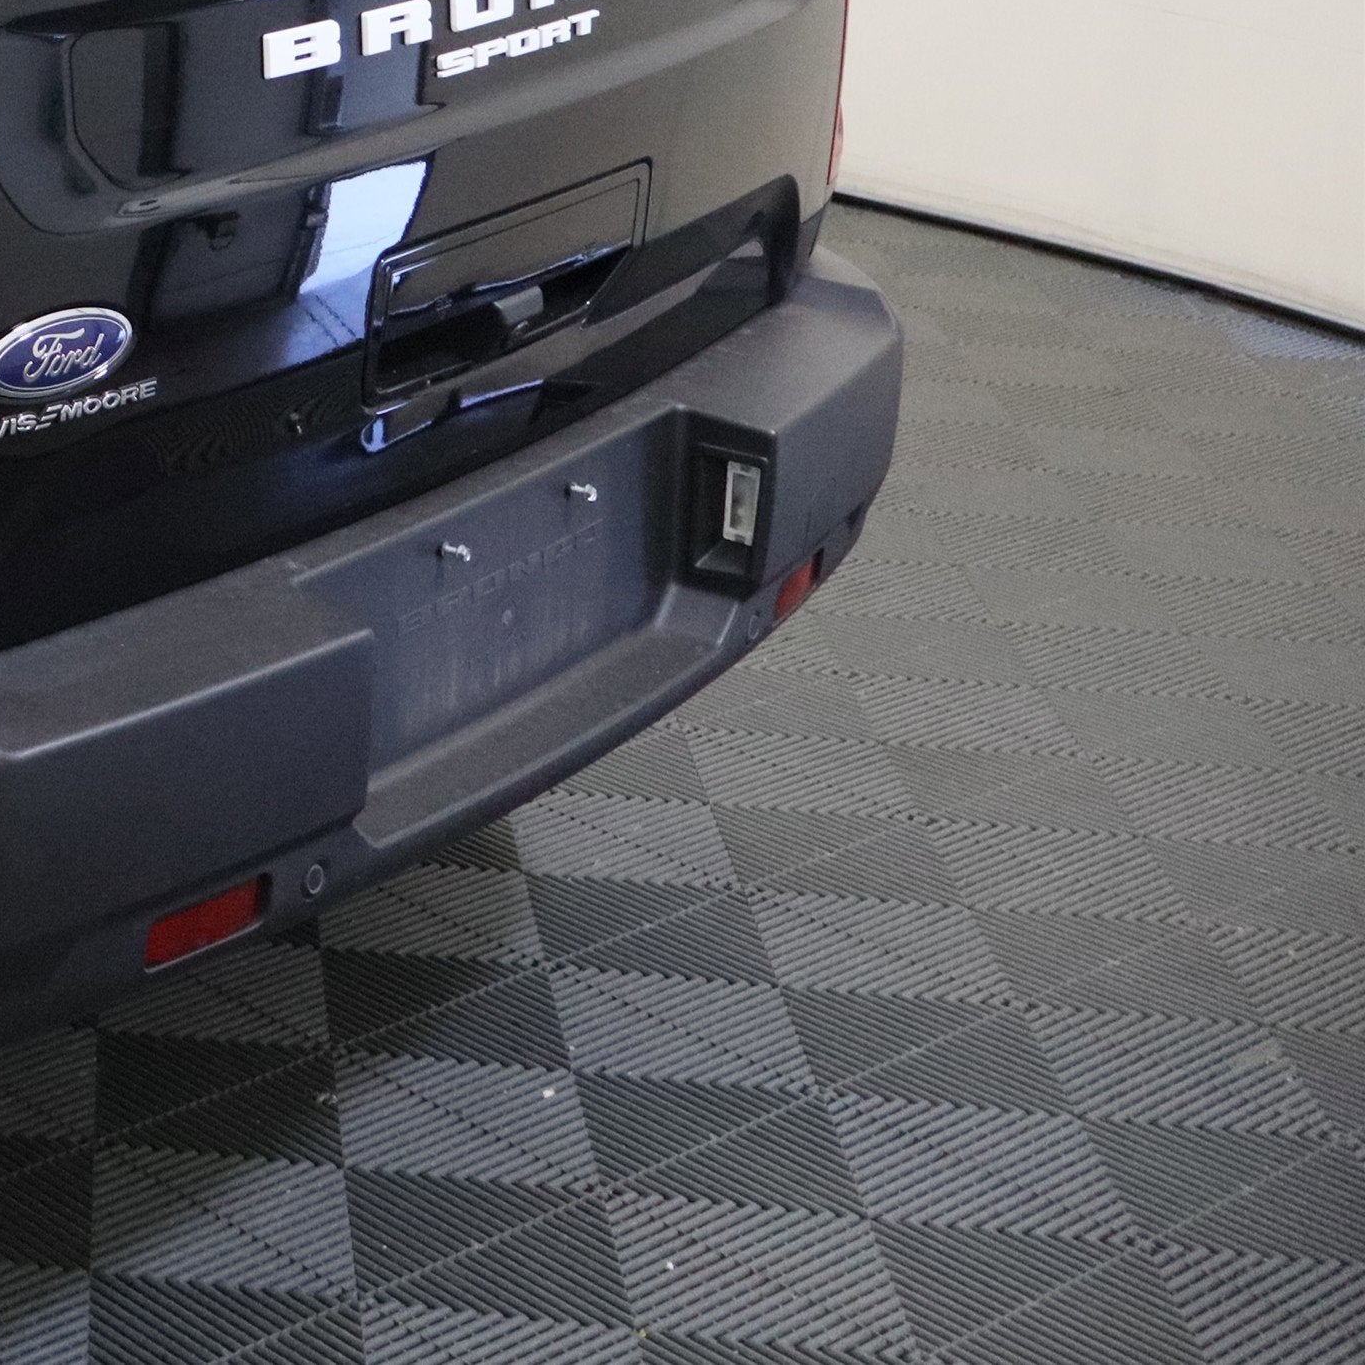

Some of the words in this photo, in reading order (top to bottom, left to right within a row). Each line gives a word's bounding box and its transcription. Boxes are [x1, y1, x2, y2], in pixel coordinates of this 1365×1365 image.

[435, 9, 600, 79] SPORT
[22, 327, 105, 383] Ford
[59, 376, 158, 422] MOORE
